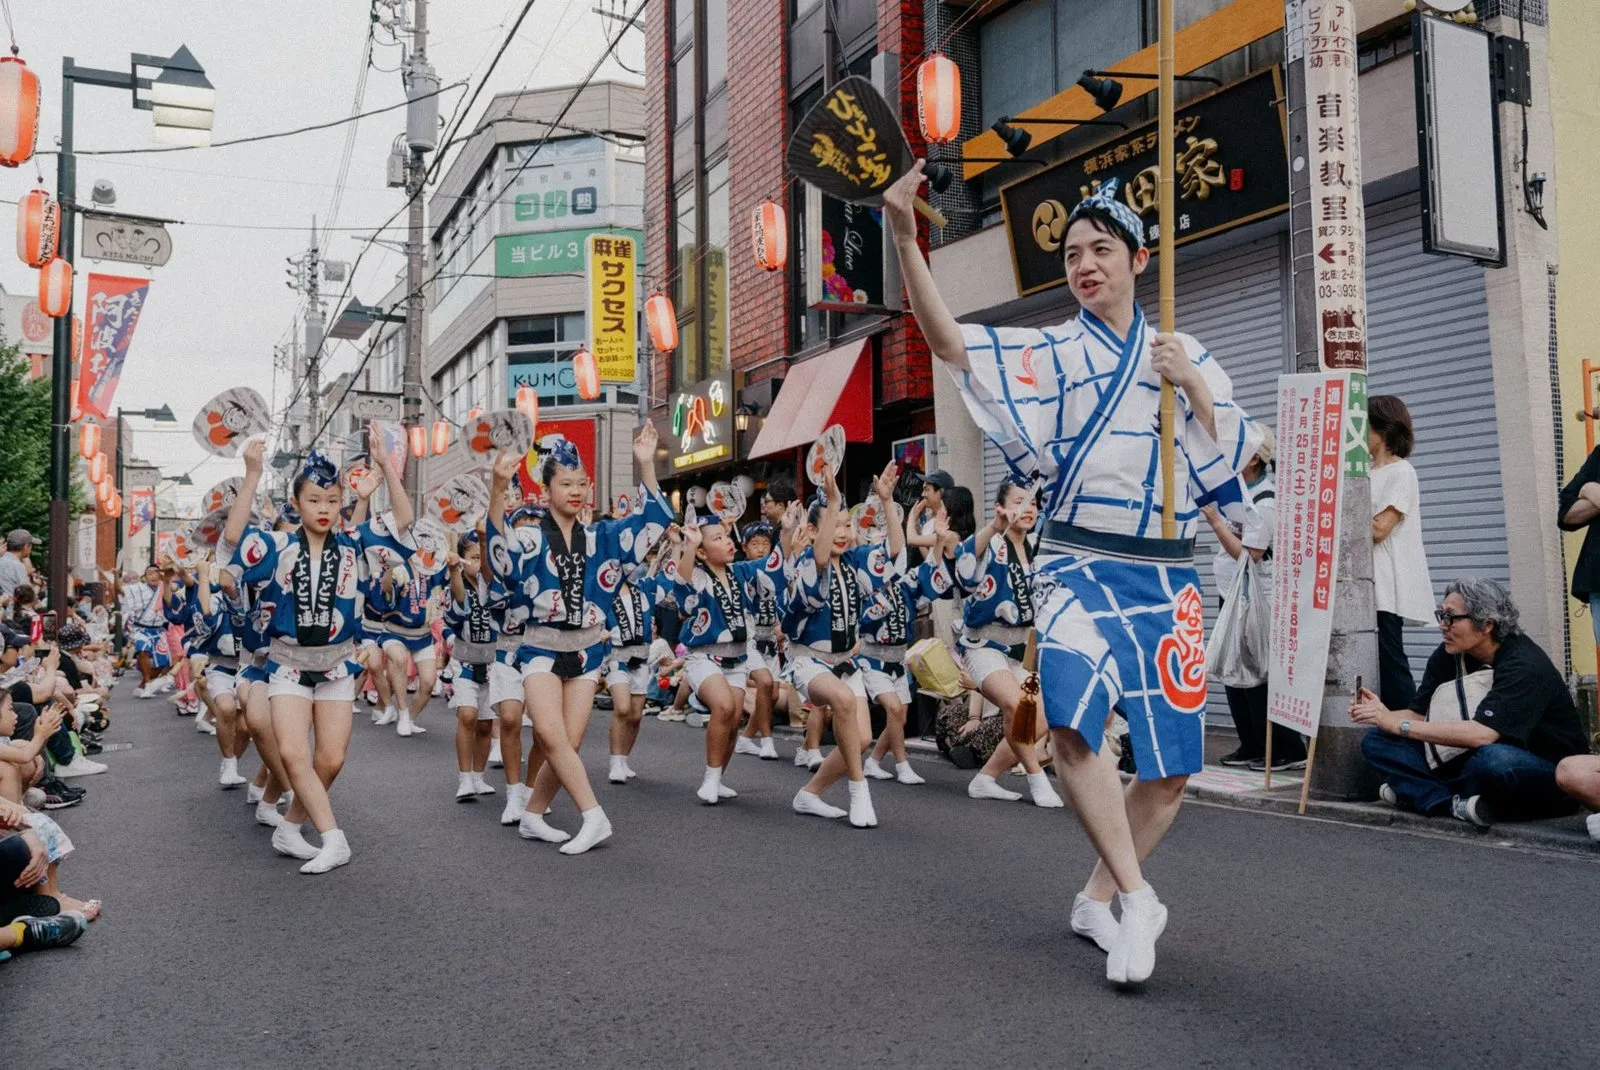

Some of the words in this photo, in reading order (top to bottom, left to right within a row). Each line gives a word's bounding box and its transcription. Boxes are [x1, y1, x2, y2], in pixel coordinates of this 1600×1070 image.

[1317, 91, 1348, 221] 音楽教室
[594, 239, 632, 259] 麻雀
[843, 227, 864, 271] Luce
[601, 260, 626, 334] サクセス
[514, 367, 577, 388] KUMO
[1308, 386, 1322, 494] きたまち阿波おどり
[1315, 386, 1341, 604] 通行止めのお知らせ
[314, 548, 338, 627] ひょっとこ連
[570, 551, 586, 626] ひょっとこ連
